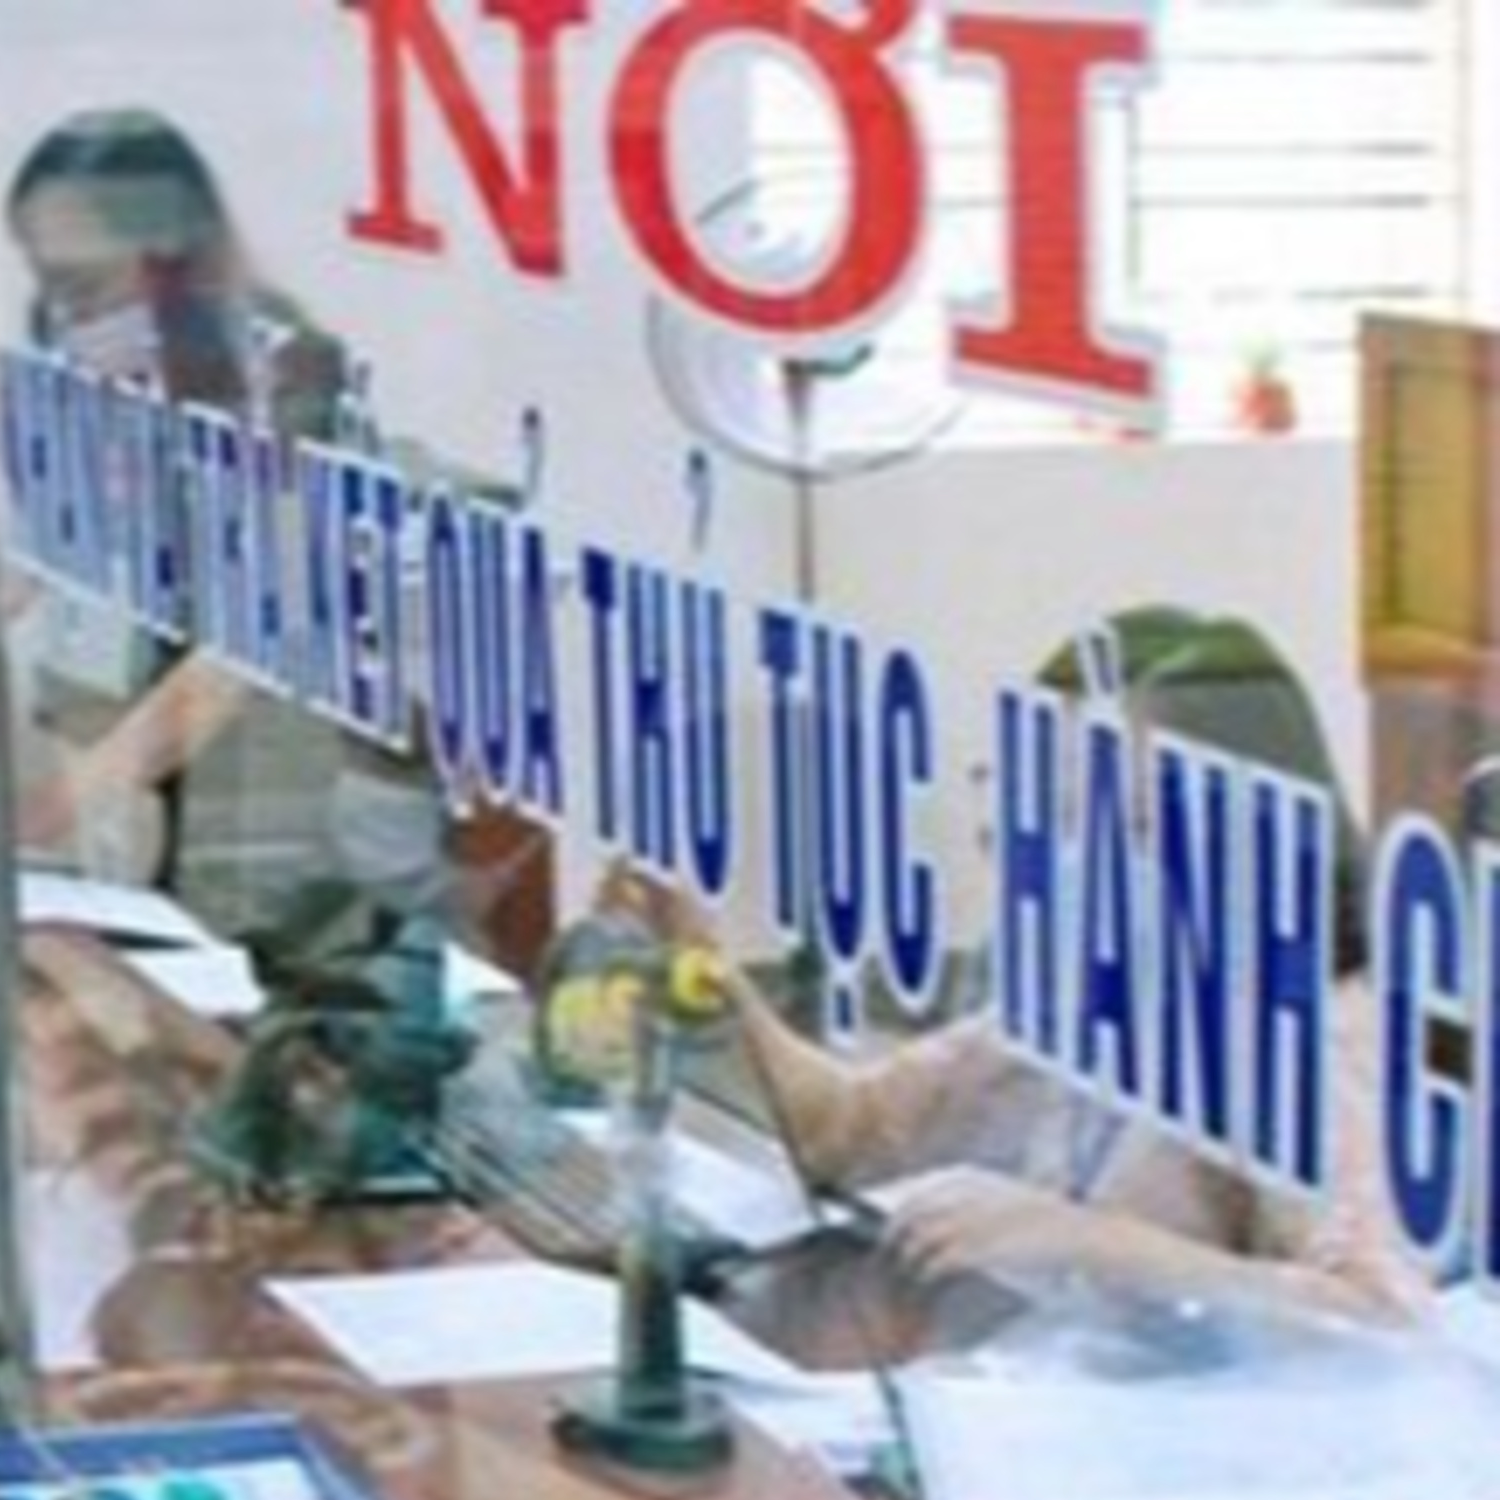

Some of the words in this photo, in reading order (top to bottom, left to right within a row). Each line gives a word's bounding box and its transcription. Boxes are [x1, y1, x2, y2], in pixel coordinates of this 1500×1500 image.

[343, 0, 1155, 397] NƠI
[426, 406, 564, 816] QUẢ
[582, 448, 730, 894] THỦ
[760, 606, 933, 1032] TỤC
[1000, 634, 1322, 1188] HÀNH
